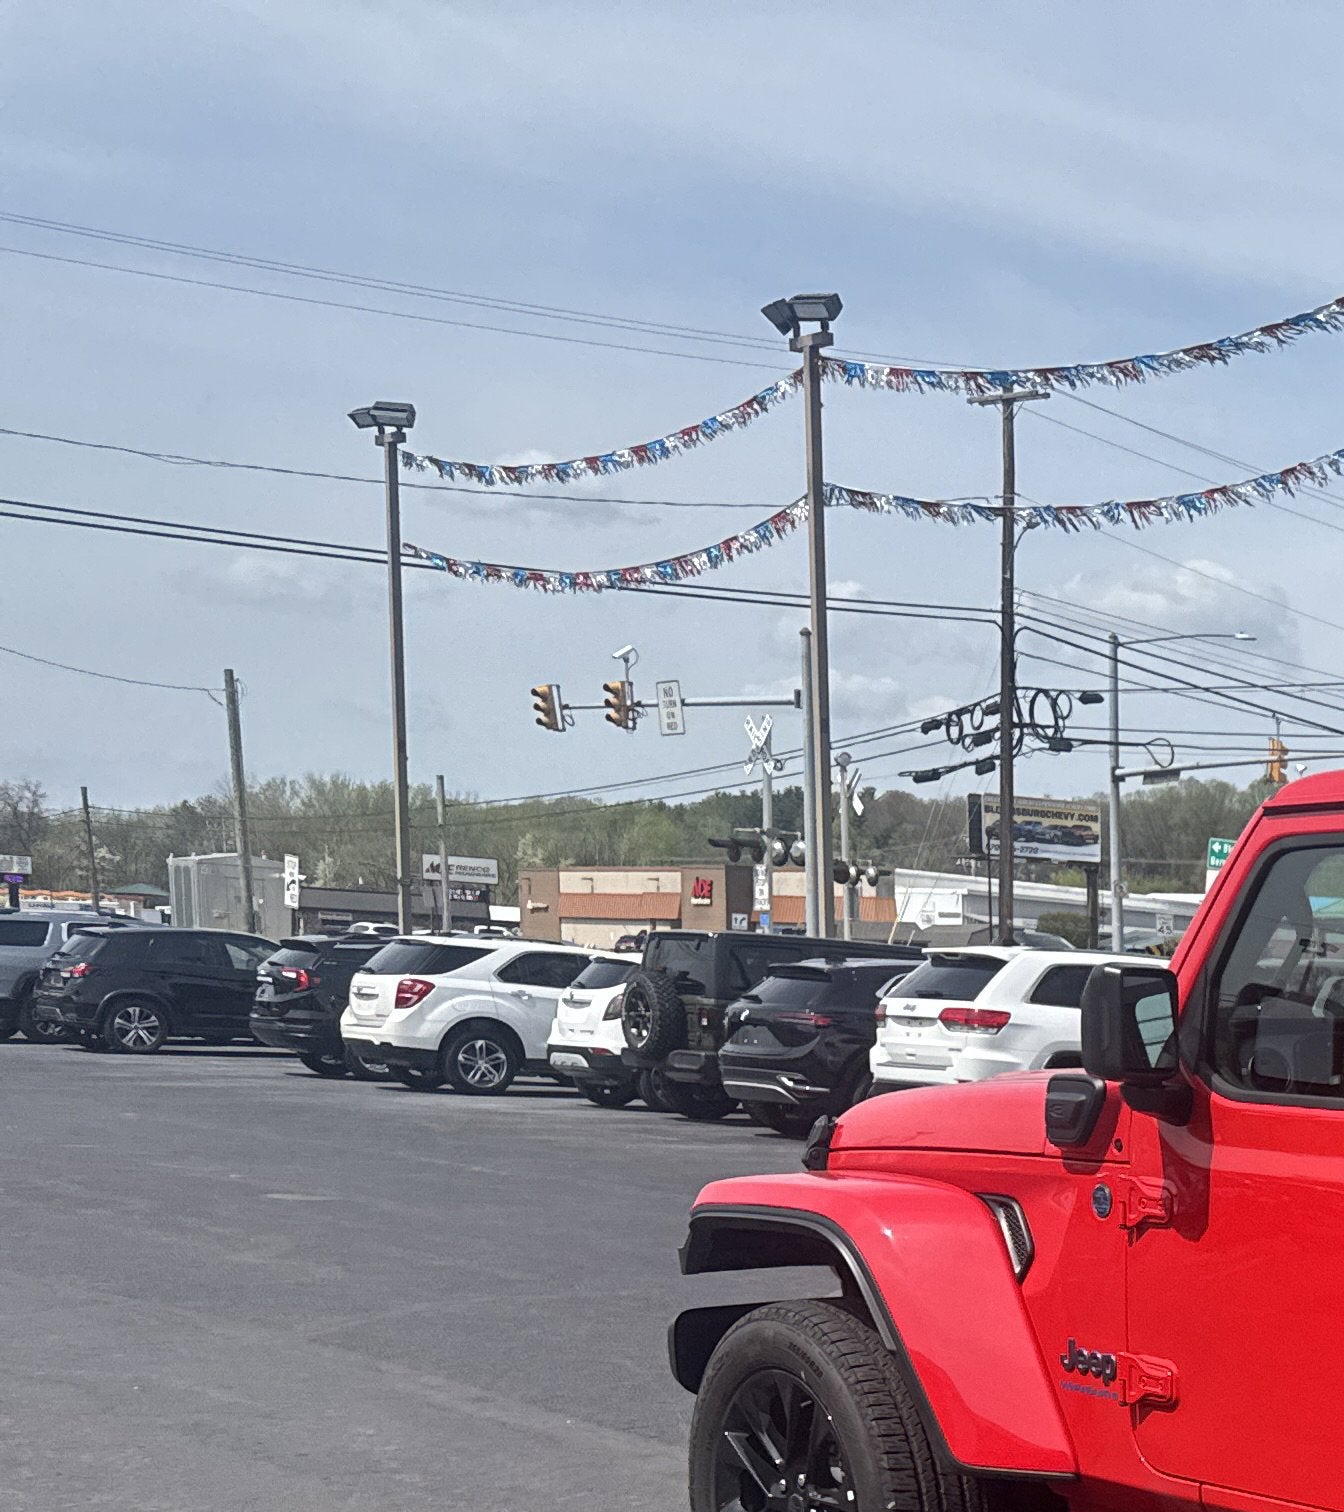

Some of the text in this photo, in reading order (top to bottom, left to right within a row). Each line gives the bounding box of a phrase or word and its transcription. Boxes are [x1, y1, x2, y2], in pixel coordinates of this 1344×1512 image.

[663, 686, 674, 698] NO
[663, 700, 677, 708] TURN
[666, 711, 676, 719] ON
[667, 722, 678, 730] RED
[691, 877, 713, 898] ACE
[1060, 1336, 1117, 1387] Jeep
